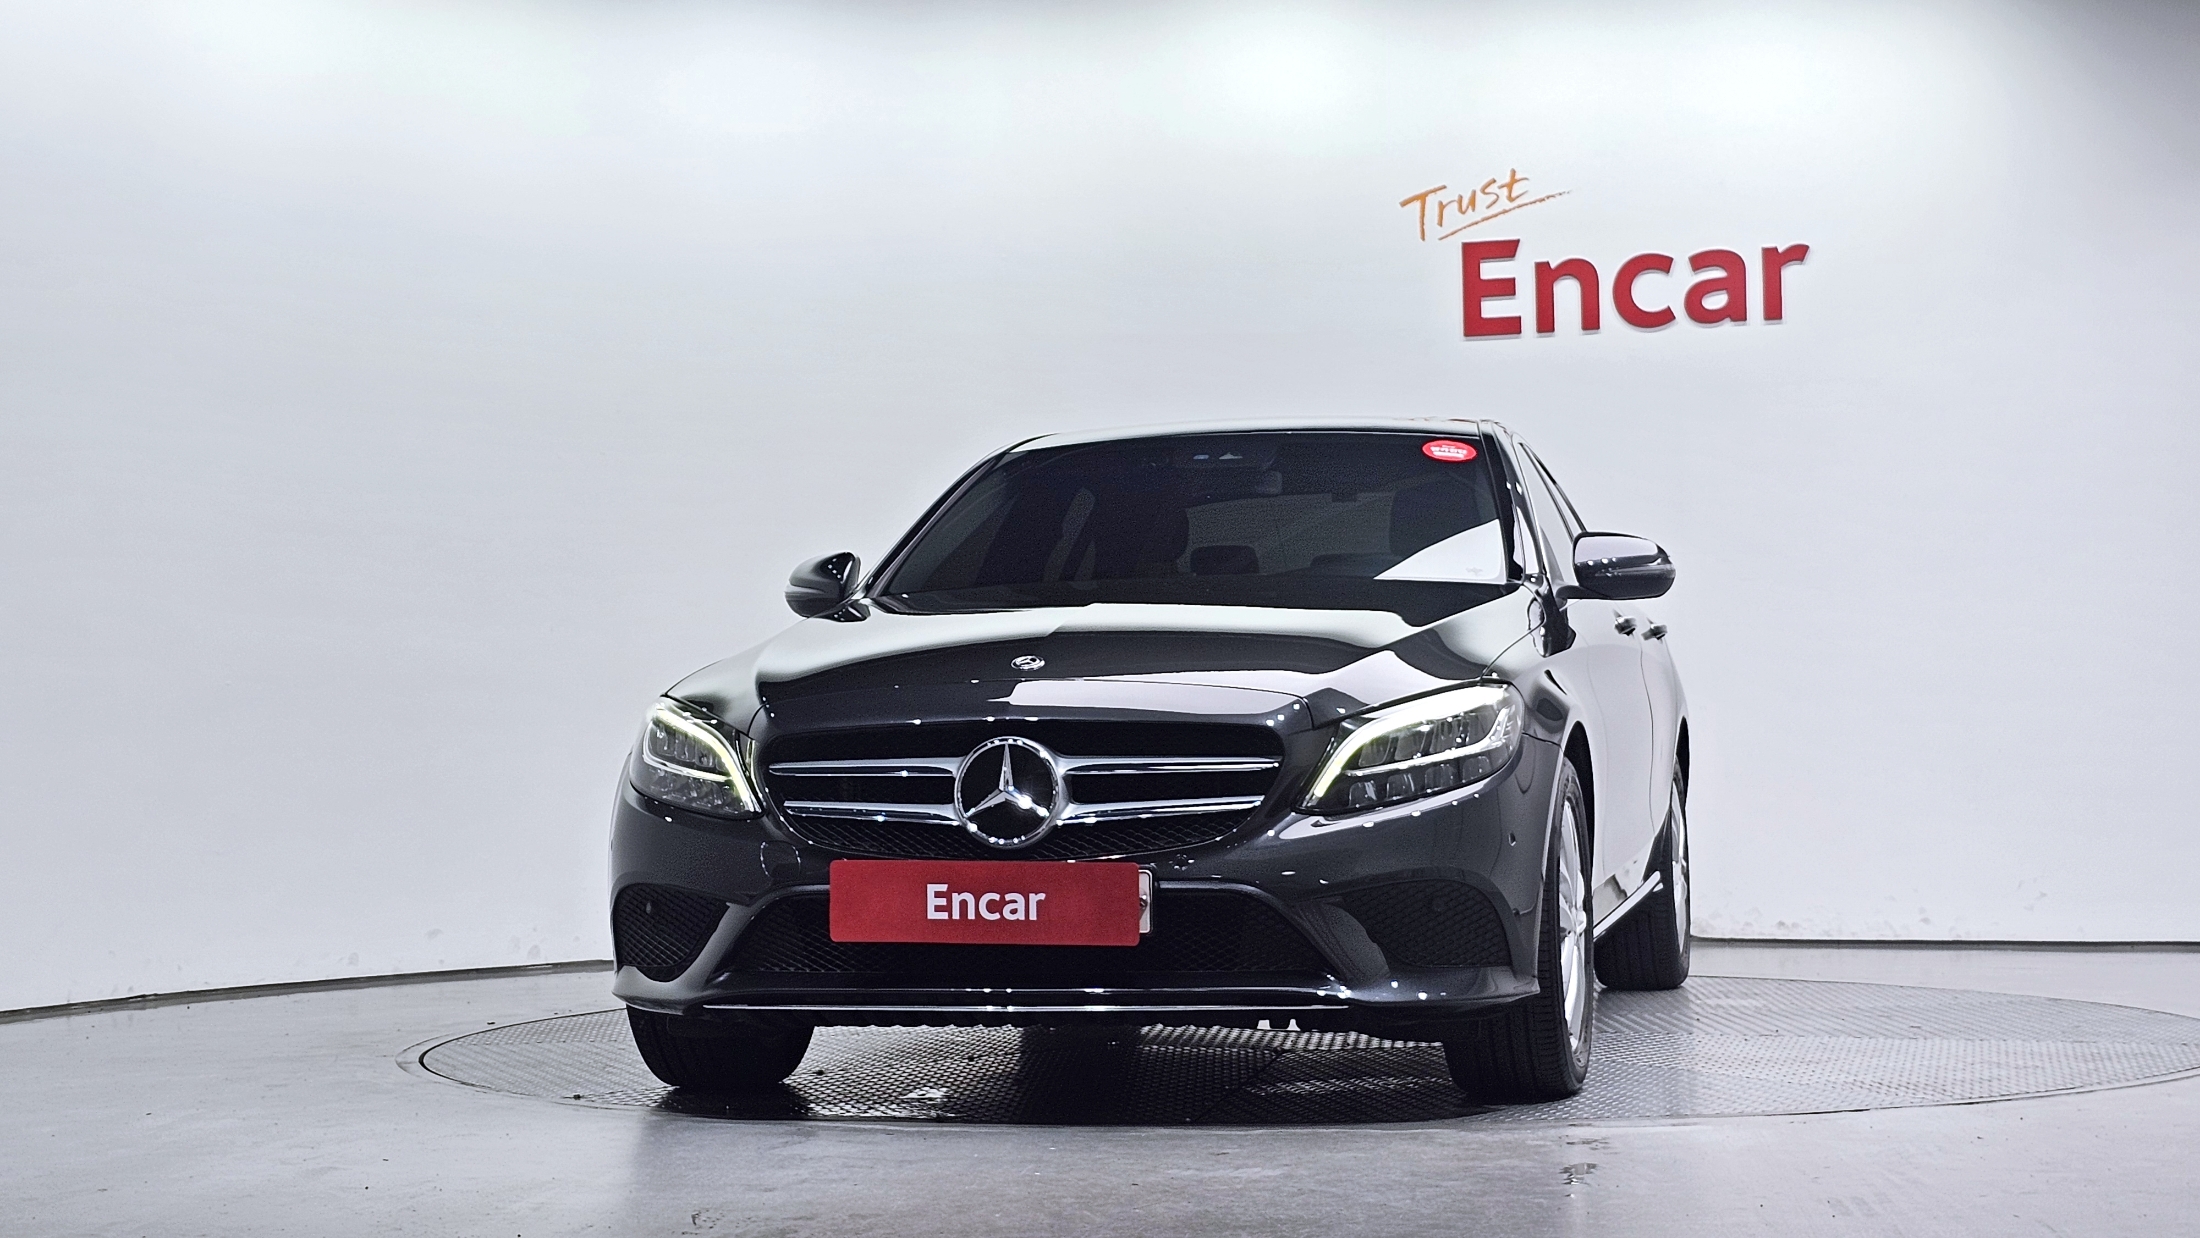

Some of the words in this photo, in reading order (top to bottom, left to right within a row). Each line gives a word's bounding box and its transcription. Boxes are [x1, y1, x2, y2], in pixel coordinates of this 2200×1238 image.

[1399, 168, 1529, 241] Trust
[1461, 238, 1810, 338] Encar
[926, 883, 1046, 921] Encar
